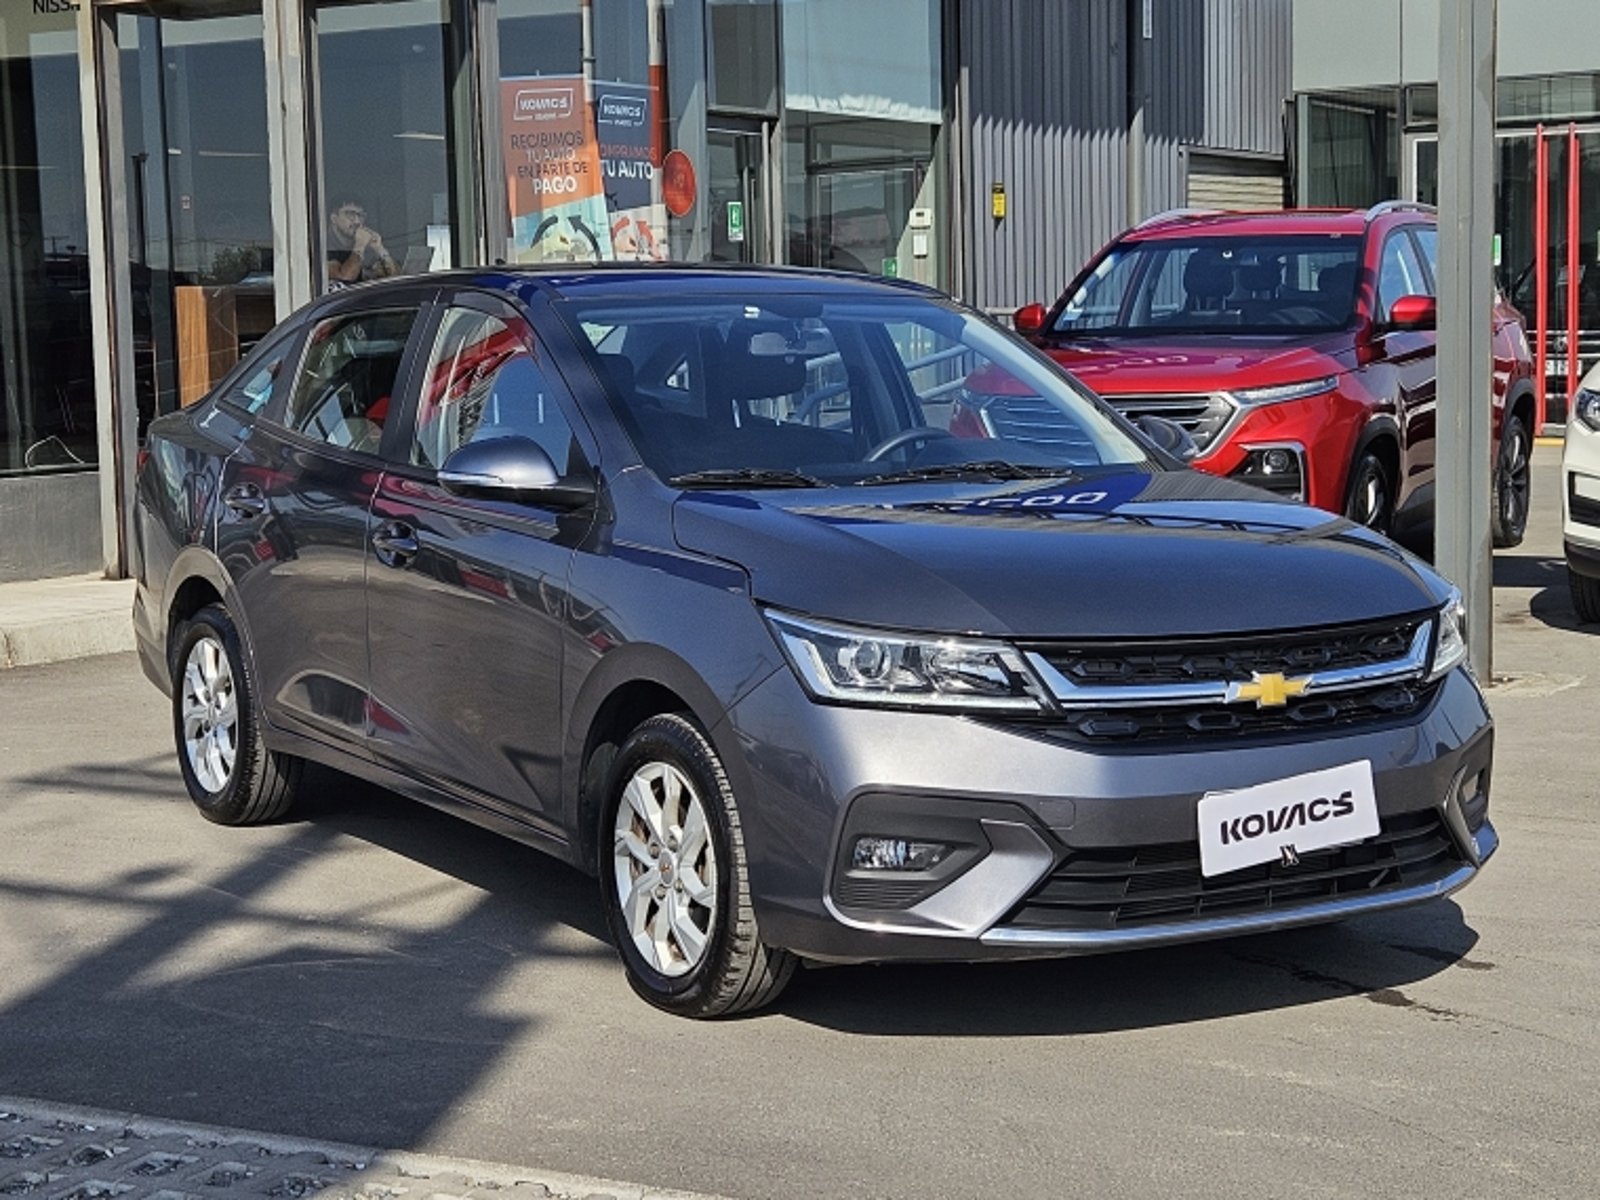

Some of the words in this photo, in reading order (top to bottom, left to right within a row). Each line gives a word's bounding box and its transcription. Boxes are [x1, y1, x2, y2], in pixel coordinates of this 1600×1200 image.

[33, 0, 80, 14] NISS
[510, 130, 584, 150] RECIBIMOS
[526, 150, 541, 163] TU
[544, 148, 576, 162] AUTO
[518, 164, 534, 178] EN
[536, 162, 571, 176] PARTE
[574, 161, 589, 174] DE
[600, 159, 616, 177] TU
[618, 160, 654, 180] AUTO
[533, 176, 577, 194] PAGO
[1220, 791, 1354, 845] KOVACS
